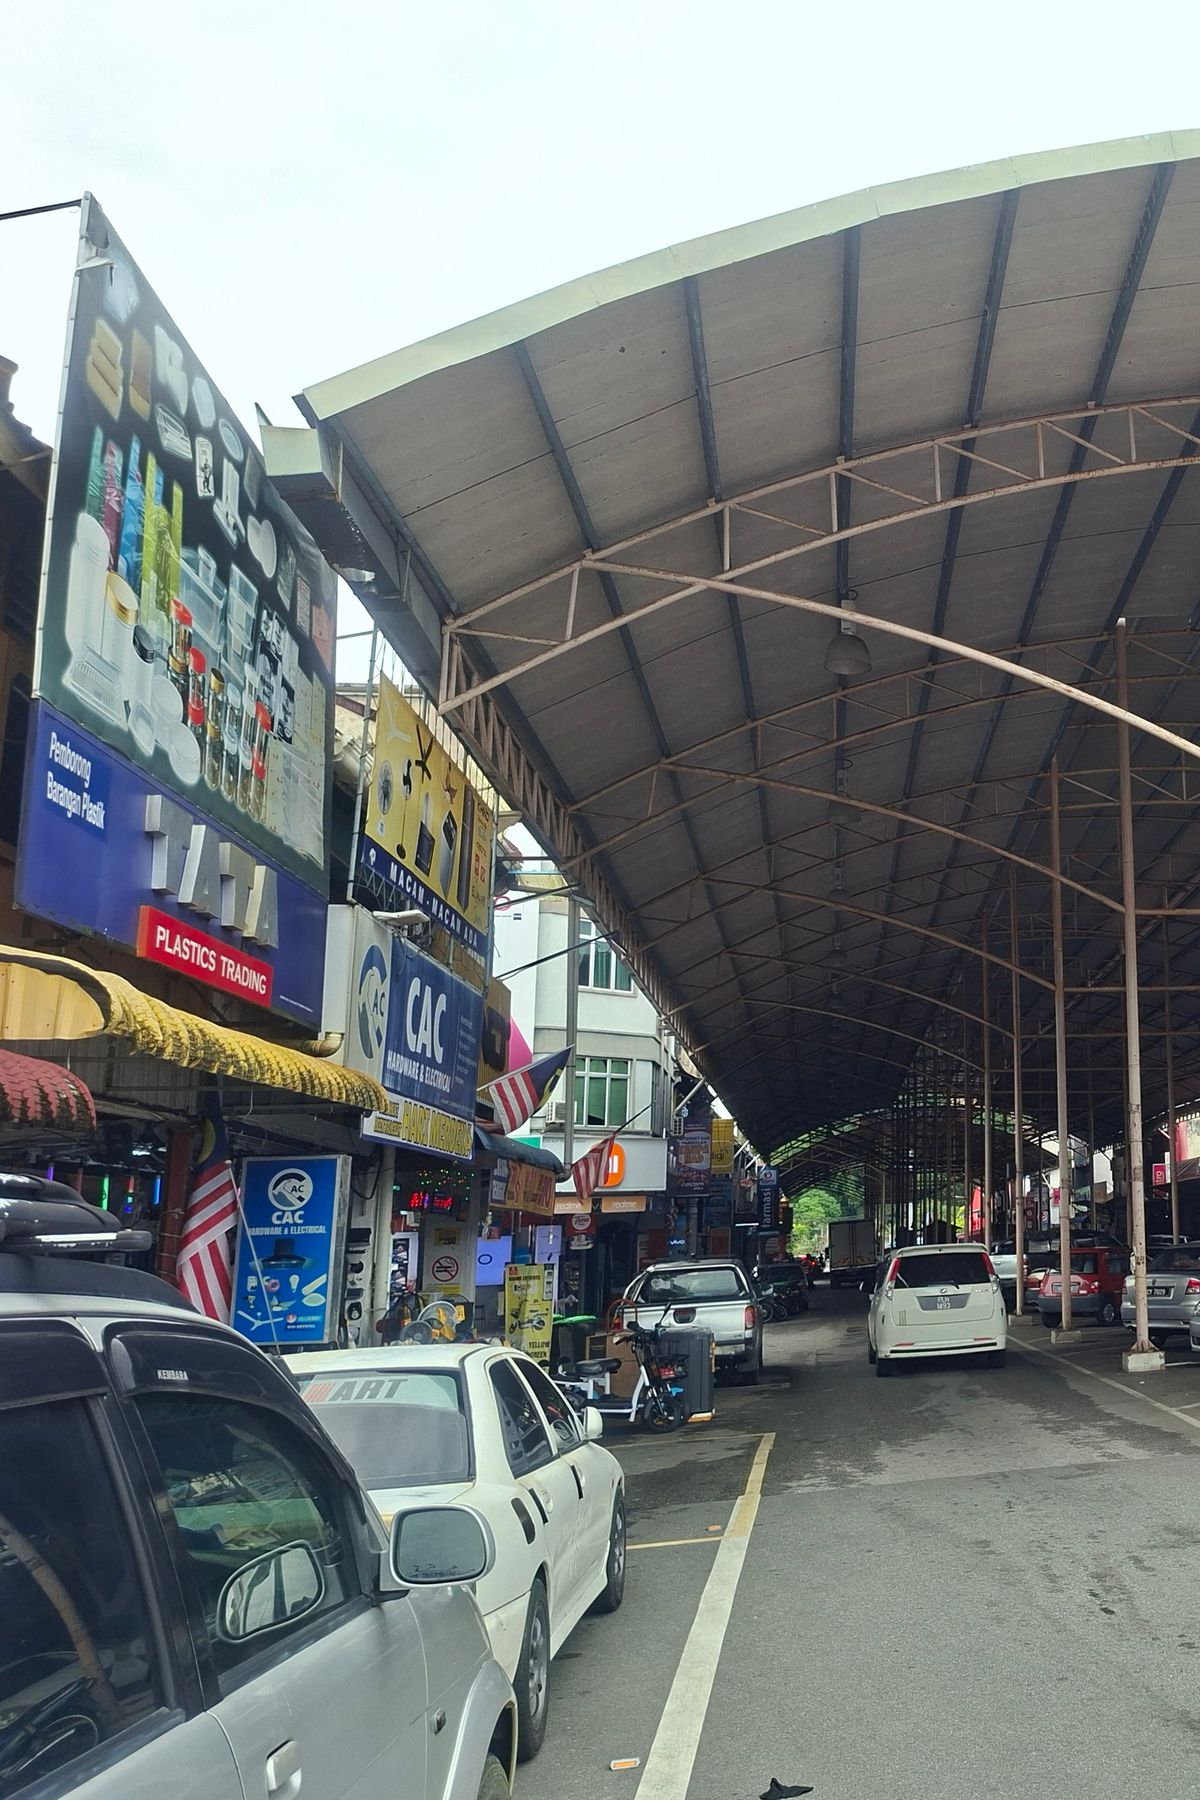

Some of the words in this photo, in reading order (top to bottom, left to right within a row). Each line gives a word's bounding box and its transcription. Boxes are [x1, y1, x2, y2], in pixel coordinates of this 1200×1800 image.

[49, 732, 91, 788] Pemborong
[47, 771, 81, 818] Barangan
[82, 792, 105, 829] Plastik
[390, 862, 424, 905] MACAM
[432, 898, 462, 935] MACAM
[463, 926, 478, 947] ADA
[156, 924, 216, 972] PLASTICS
[220, 956, 266, 994] TRADING
[406, 976, 446, 1064] CAC
[387, 1050, 420, 1080] HARDWARE
[420, 1069, 424, 1082] &
[425, 1066, 451, 1093] ELECTRICAL
[402, 1100, 430, 1147] HARI
[429, 1110, 472, 1157] MERDEKA
[290, 1185, 304, 1194] AC
[272, 1211, 304, 1224] CAC
[290, 1226, 326, 1234] ELECTRICAL
[157, 1370, 188, 1380] KEMBARA
[328, 1378, 408, 1401] ART
